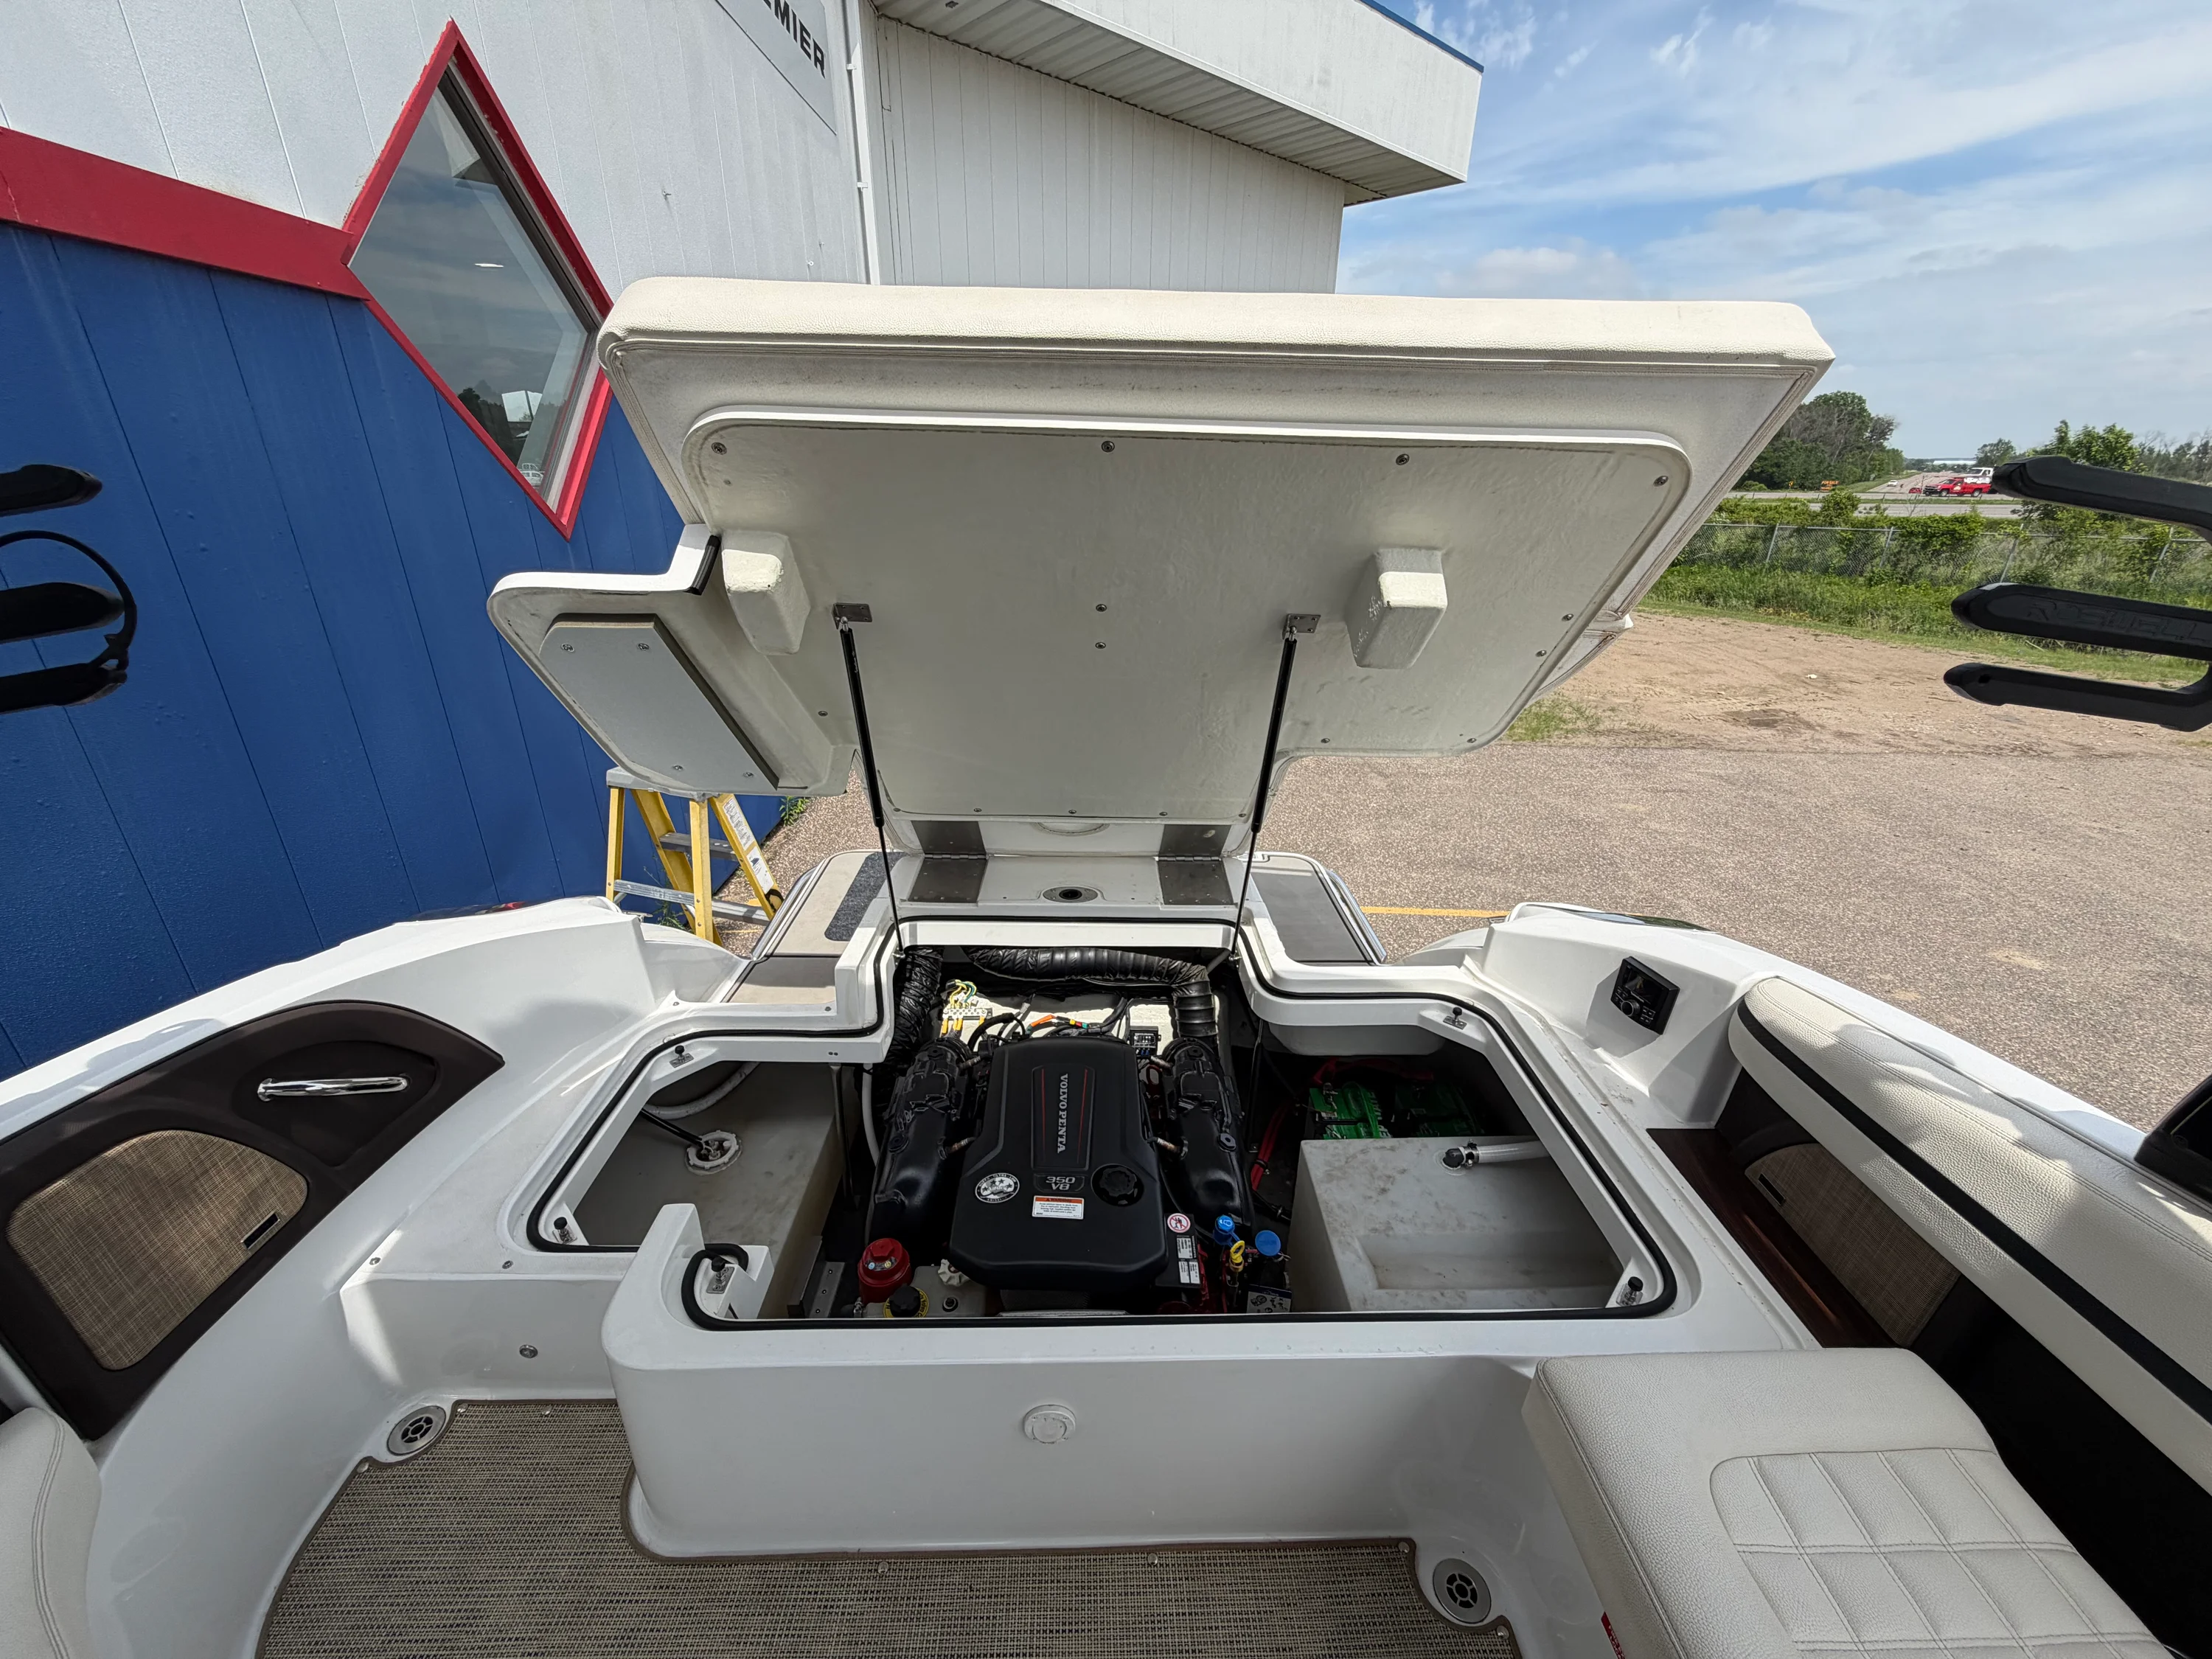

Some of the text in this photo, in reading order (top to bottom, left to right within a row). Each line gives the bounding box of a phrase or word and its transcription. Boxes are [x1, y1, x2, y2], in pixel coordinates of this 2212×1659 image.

[762, 0, 825, 79] MIER
[1057, 1074, 1068, 1153] VOLVO PENTA
